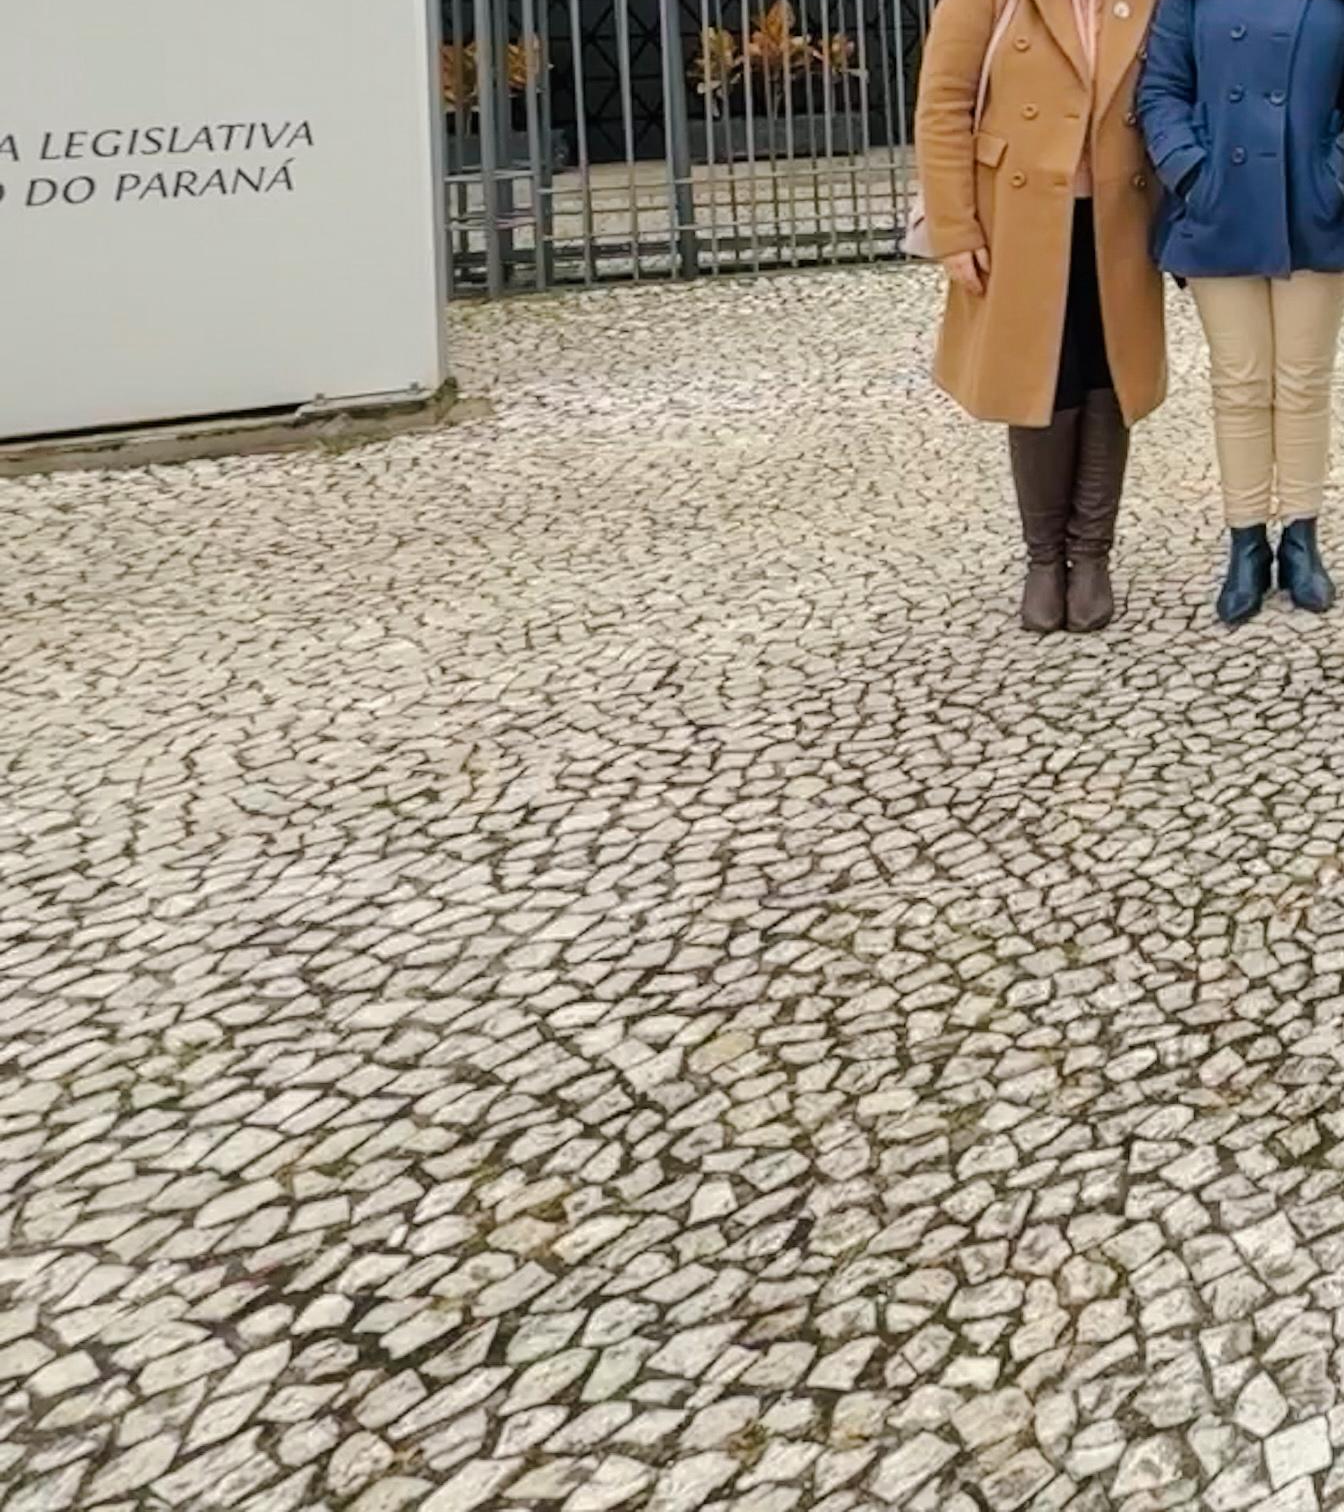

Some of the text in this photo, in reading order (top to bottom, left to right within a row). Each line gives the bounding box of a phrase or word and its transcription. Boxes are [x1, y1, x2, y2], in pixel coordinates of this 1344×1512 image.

[39, 120, 316, 161] LEGISLATIVA
[25, 175, 97, 207] DO
[114, 157, 296, 202] PARANÁ
